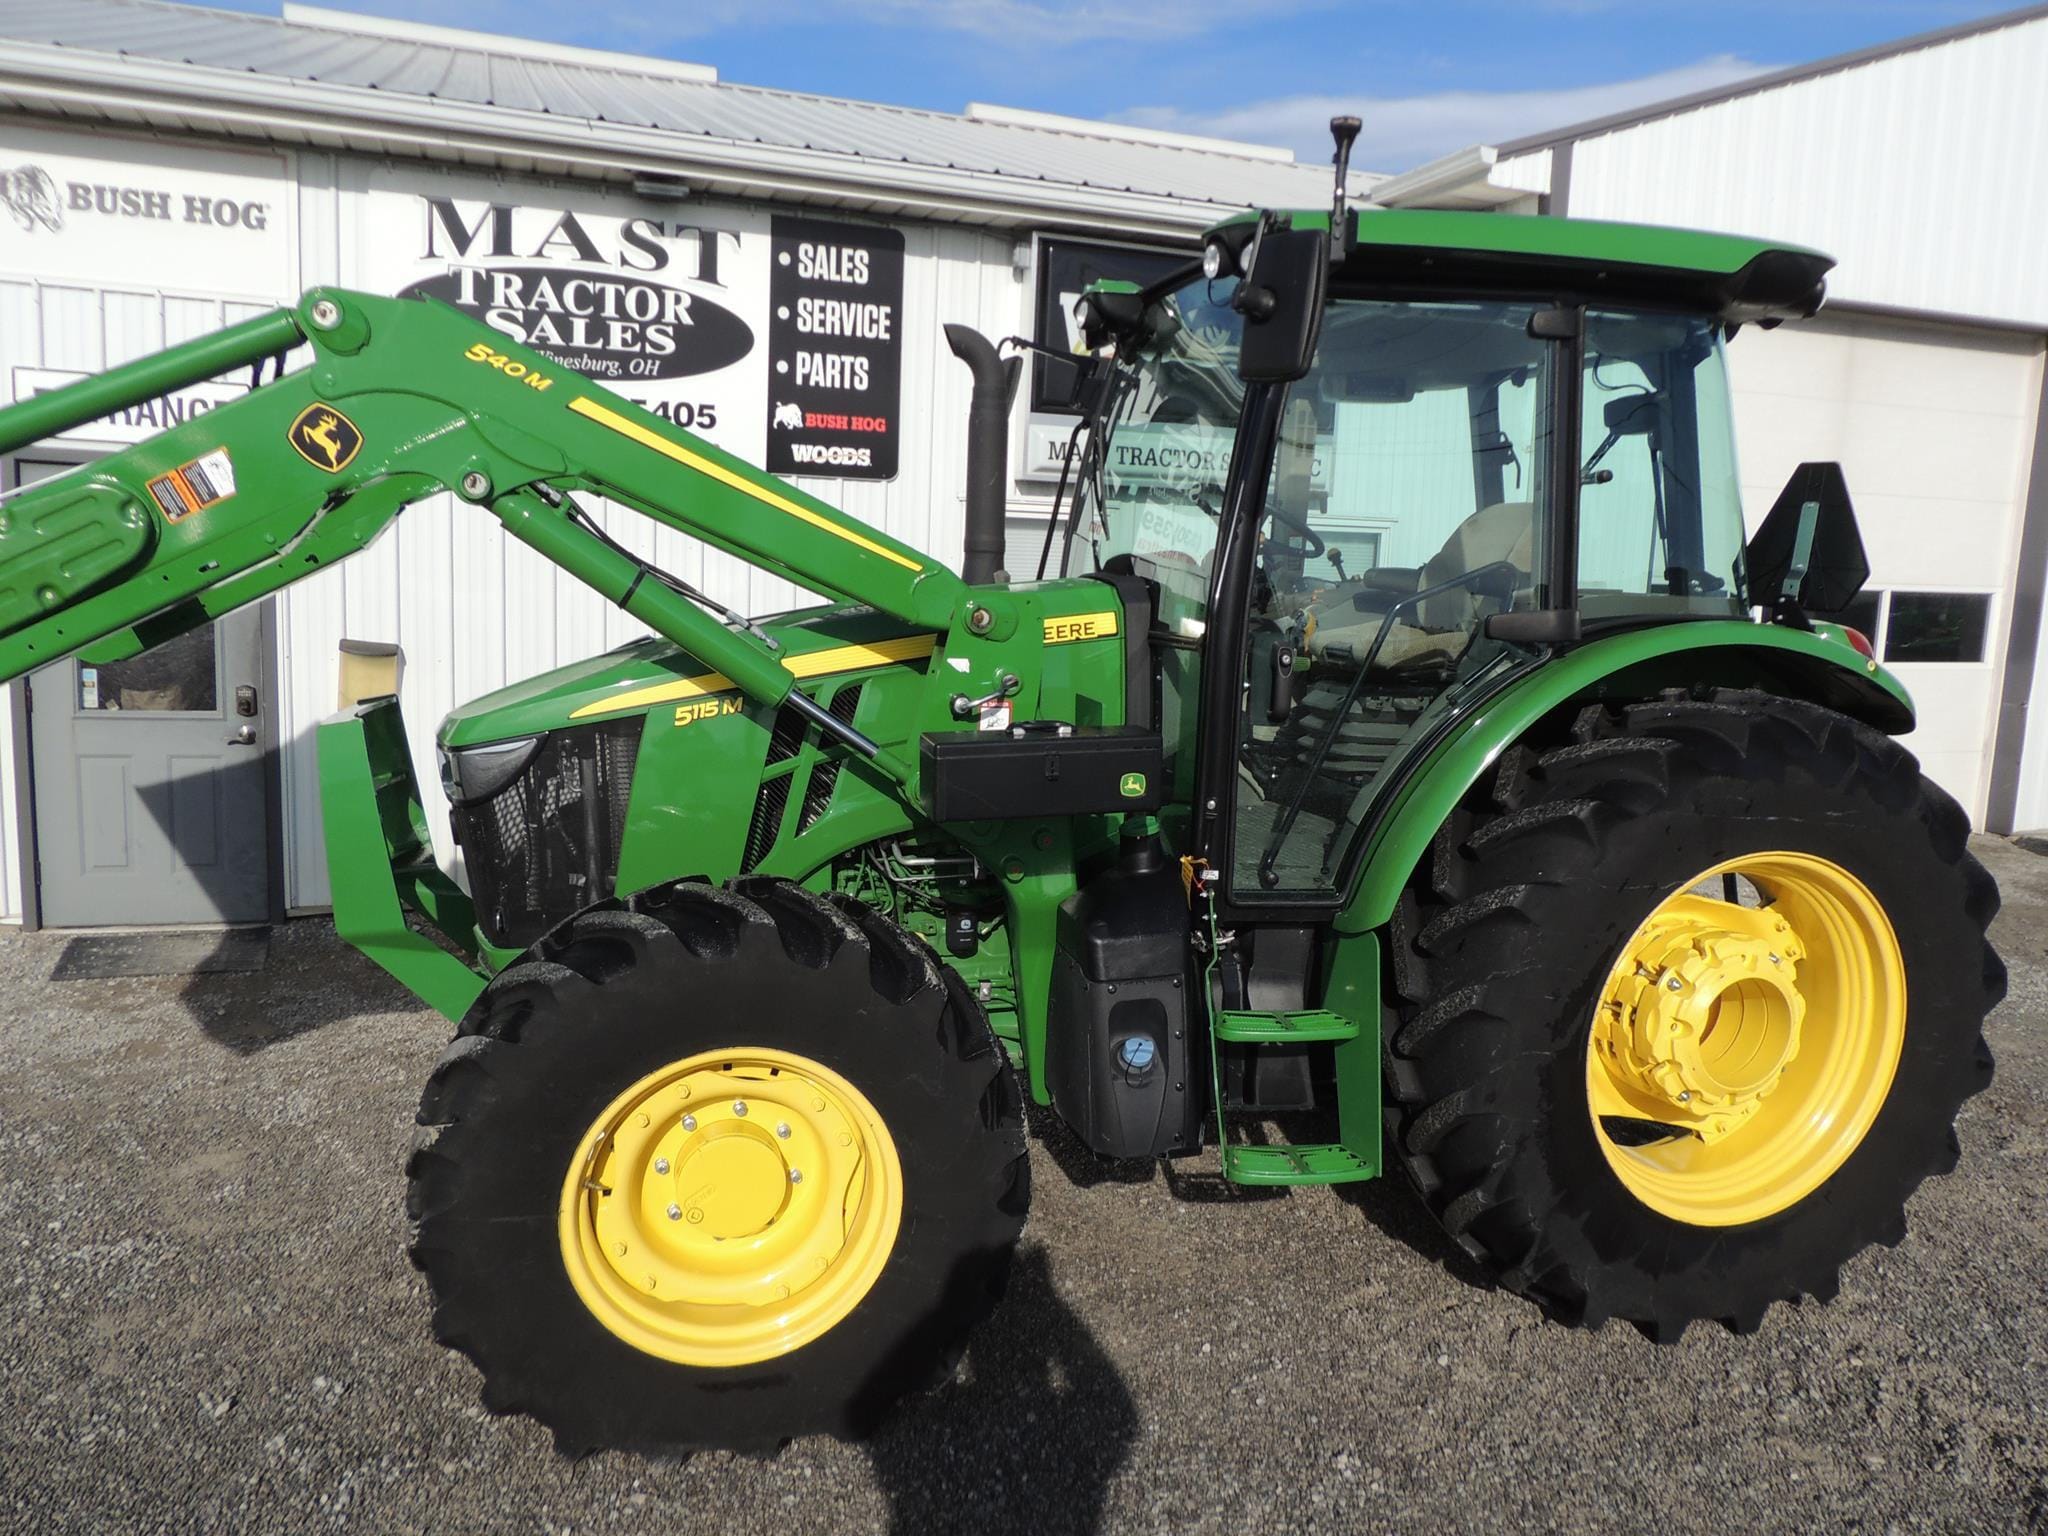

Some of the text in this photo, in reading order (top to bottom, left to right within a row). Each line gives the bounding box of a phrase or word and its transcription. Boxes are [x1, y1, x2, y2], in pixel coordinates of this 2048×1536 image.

[66, 181, 267, 231] BUSH HOG
[418, 195, 742, 290] MAST
[797, 242, 870, 285] SALES
[447, 263, 695, 326] TRACTOR
[485, 307, 677, 356] SALES
[796, 296, 892, 341] SERVICE
[628, 357, 662, 377] OH
[795, 350, 870, 392] PARTS
[631, 398, 718, 430] 405
[804, 412, 887, 434] BUSH HOG
[790, 442, 872, 467] WOODS
[1116, 445, 1216, 471] TRACTOR
[1043, 621, 1096, 641] EERE
